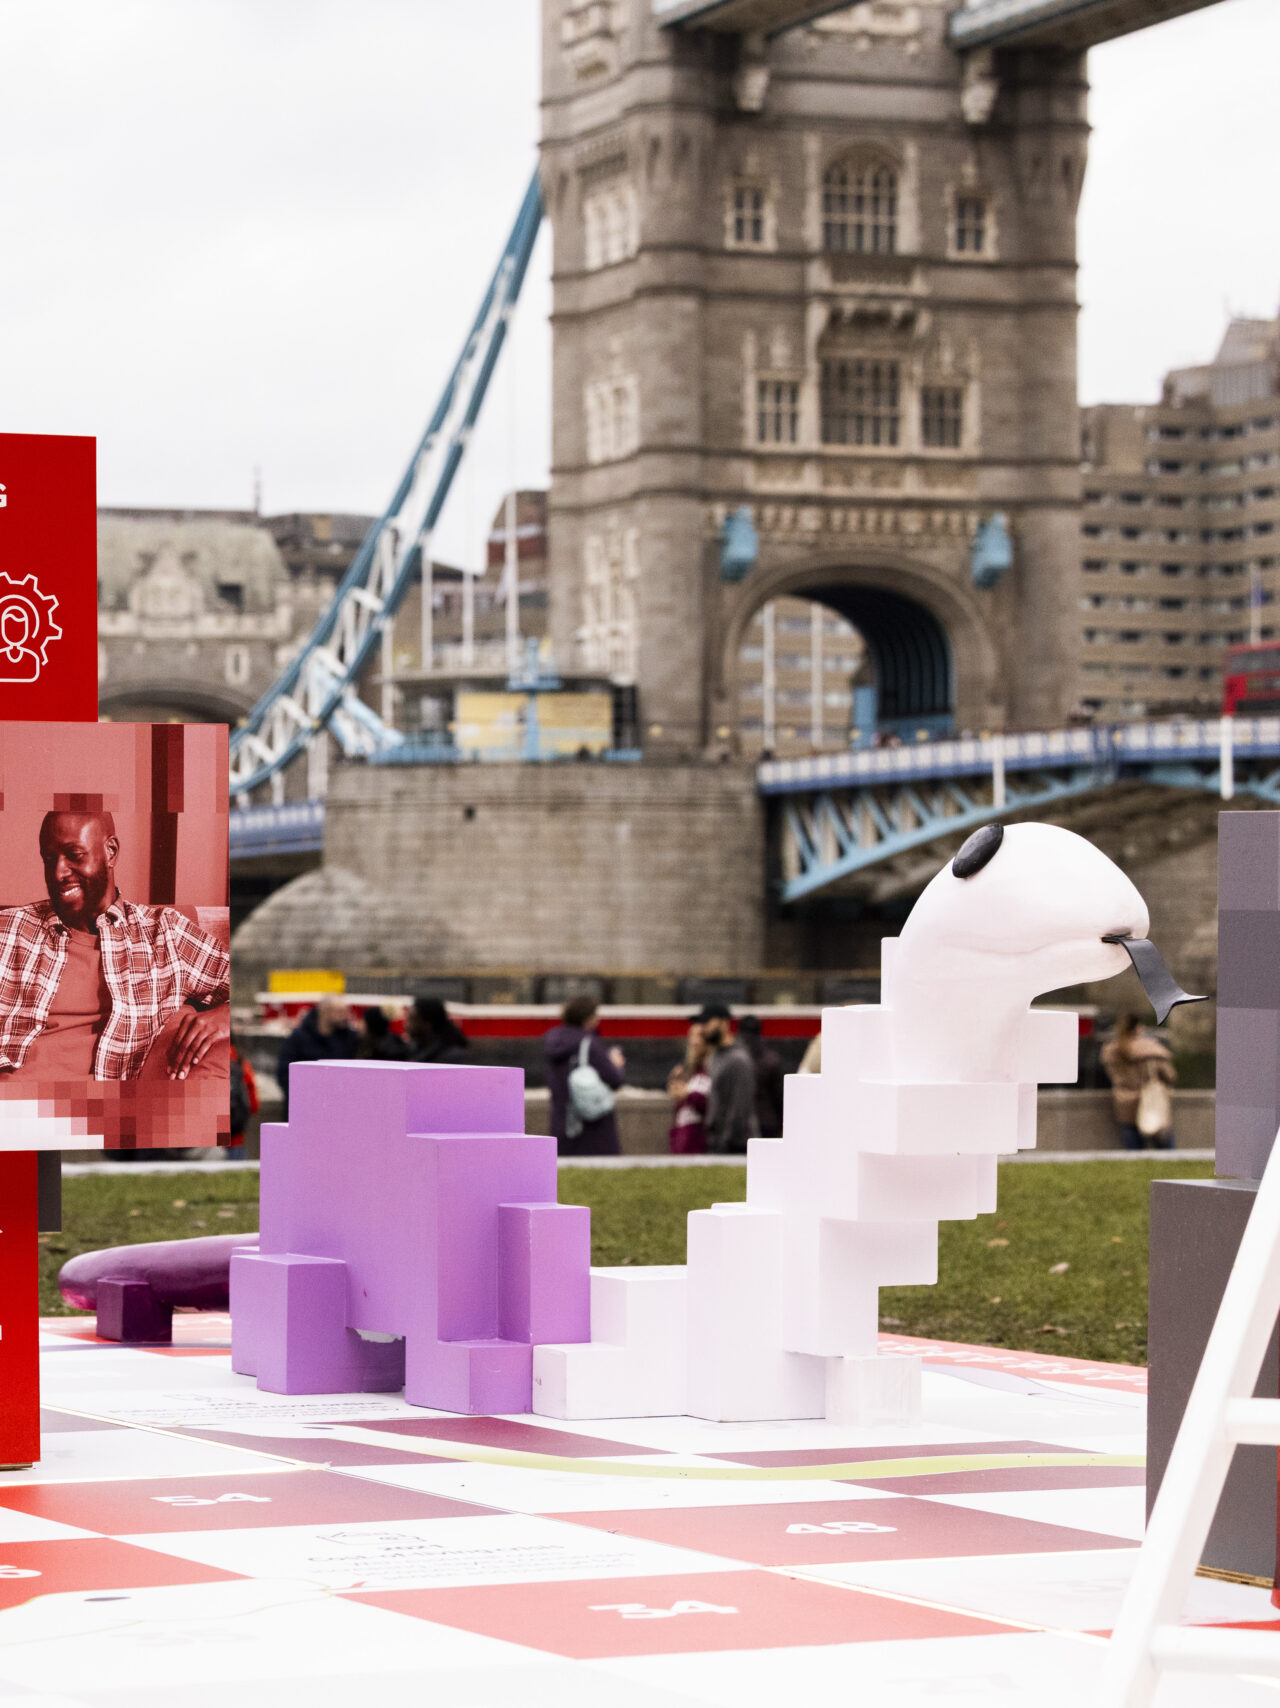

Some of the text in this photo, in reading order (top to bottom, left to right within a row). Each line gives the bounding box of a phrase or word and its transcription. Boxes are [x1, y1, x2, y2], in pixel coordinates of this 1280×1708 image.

[150, 1492, 272, 1507] 54
[785, 1521, 898, 1535] 48
[588, 1599, 740, 1619] 34
